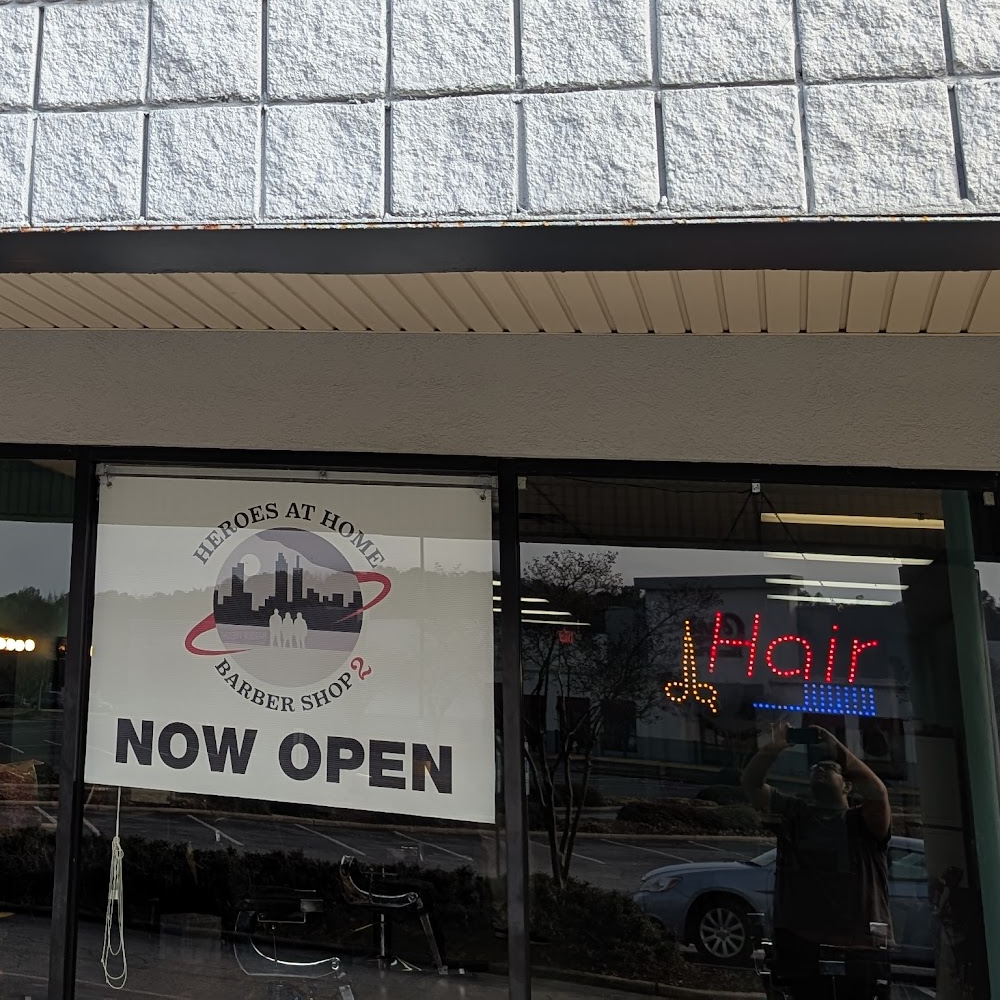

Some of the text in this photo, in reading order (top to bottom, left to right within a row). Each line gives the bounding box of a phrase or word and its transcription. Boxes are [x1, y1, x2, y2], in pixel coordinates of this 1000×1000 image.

[192, 502, 386, 568] HEROES AT HOME
[709, 610, 879, 684] Hair
[214, 656, 372, 713] BARBER SHOP 2
[115, 717, 453, 795] NOW OPEN
